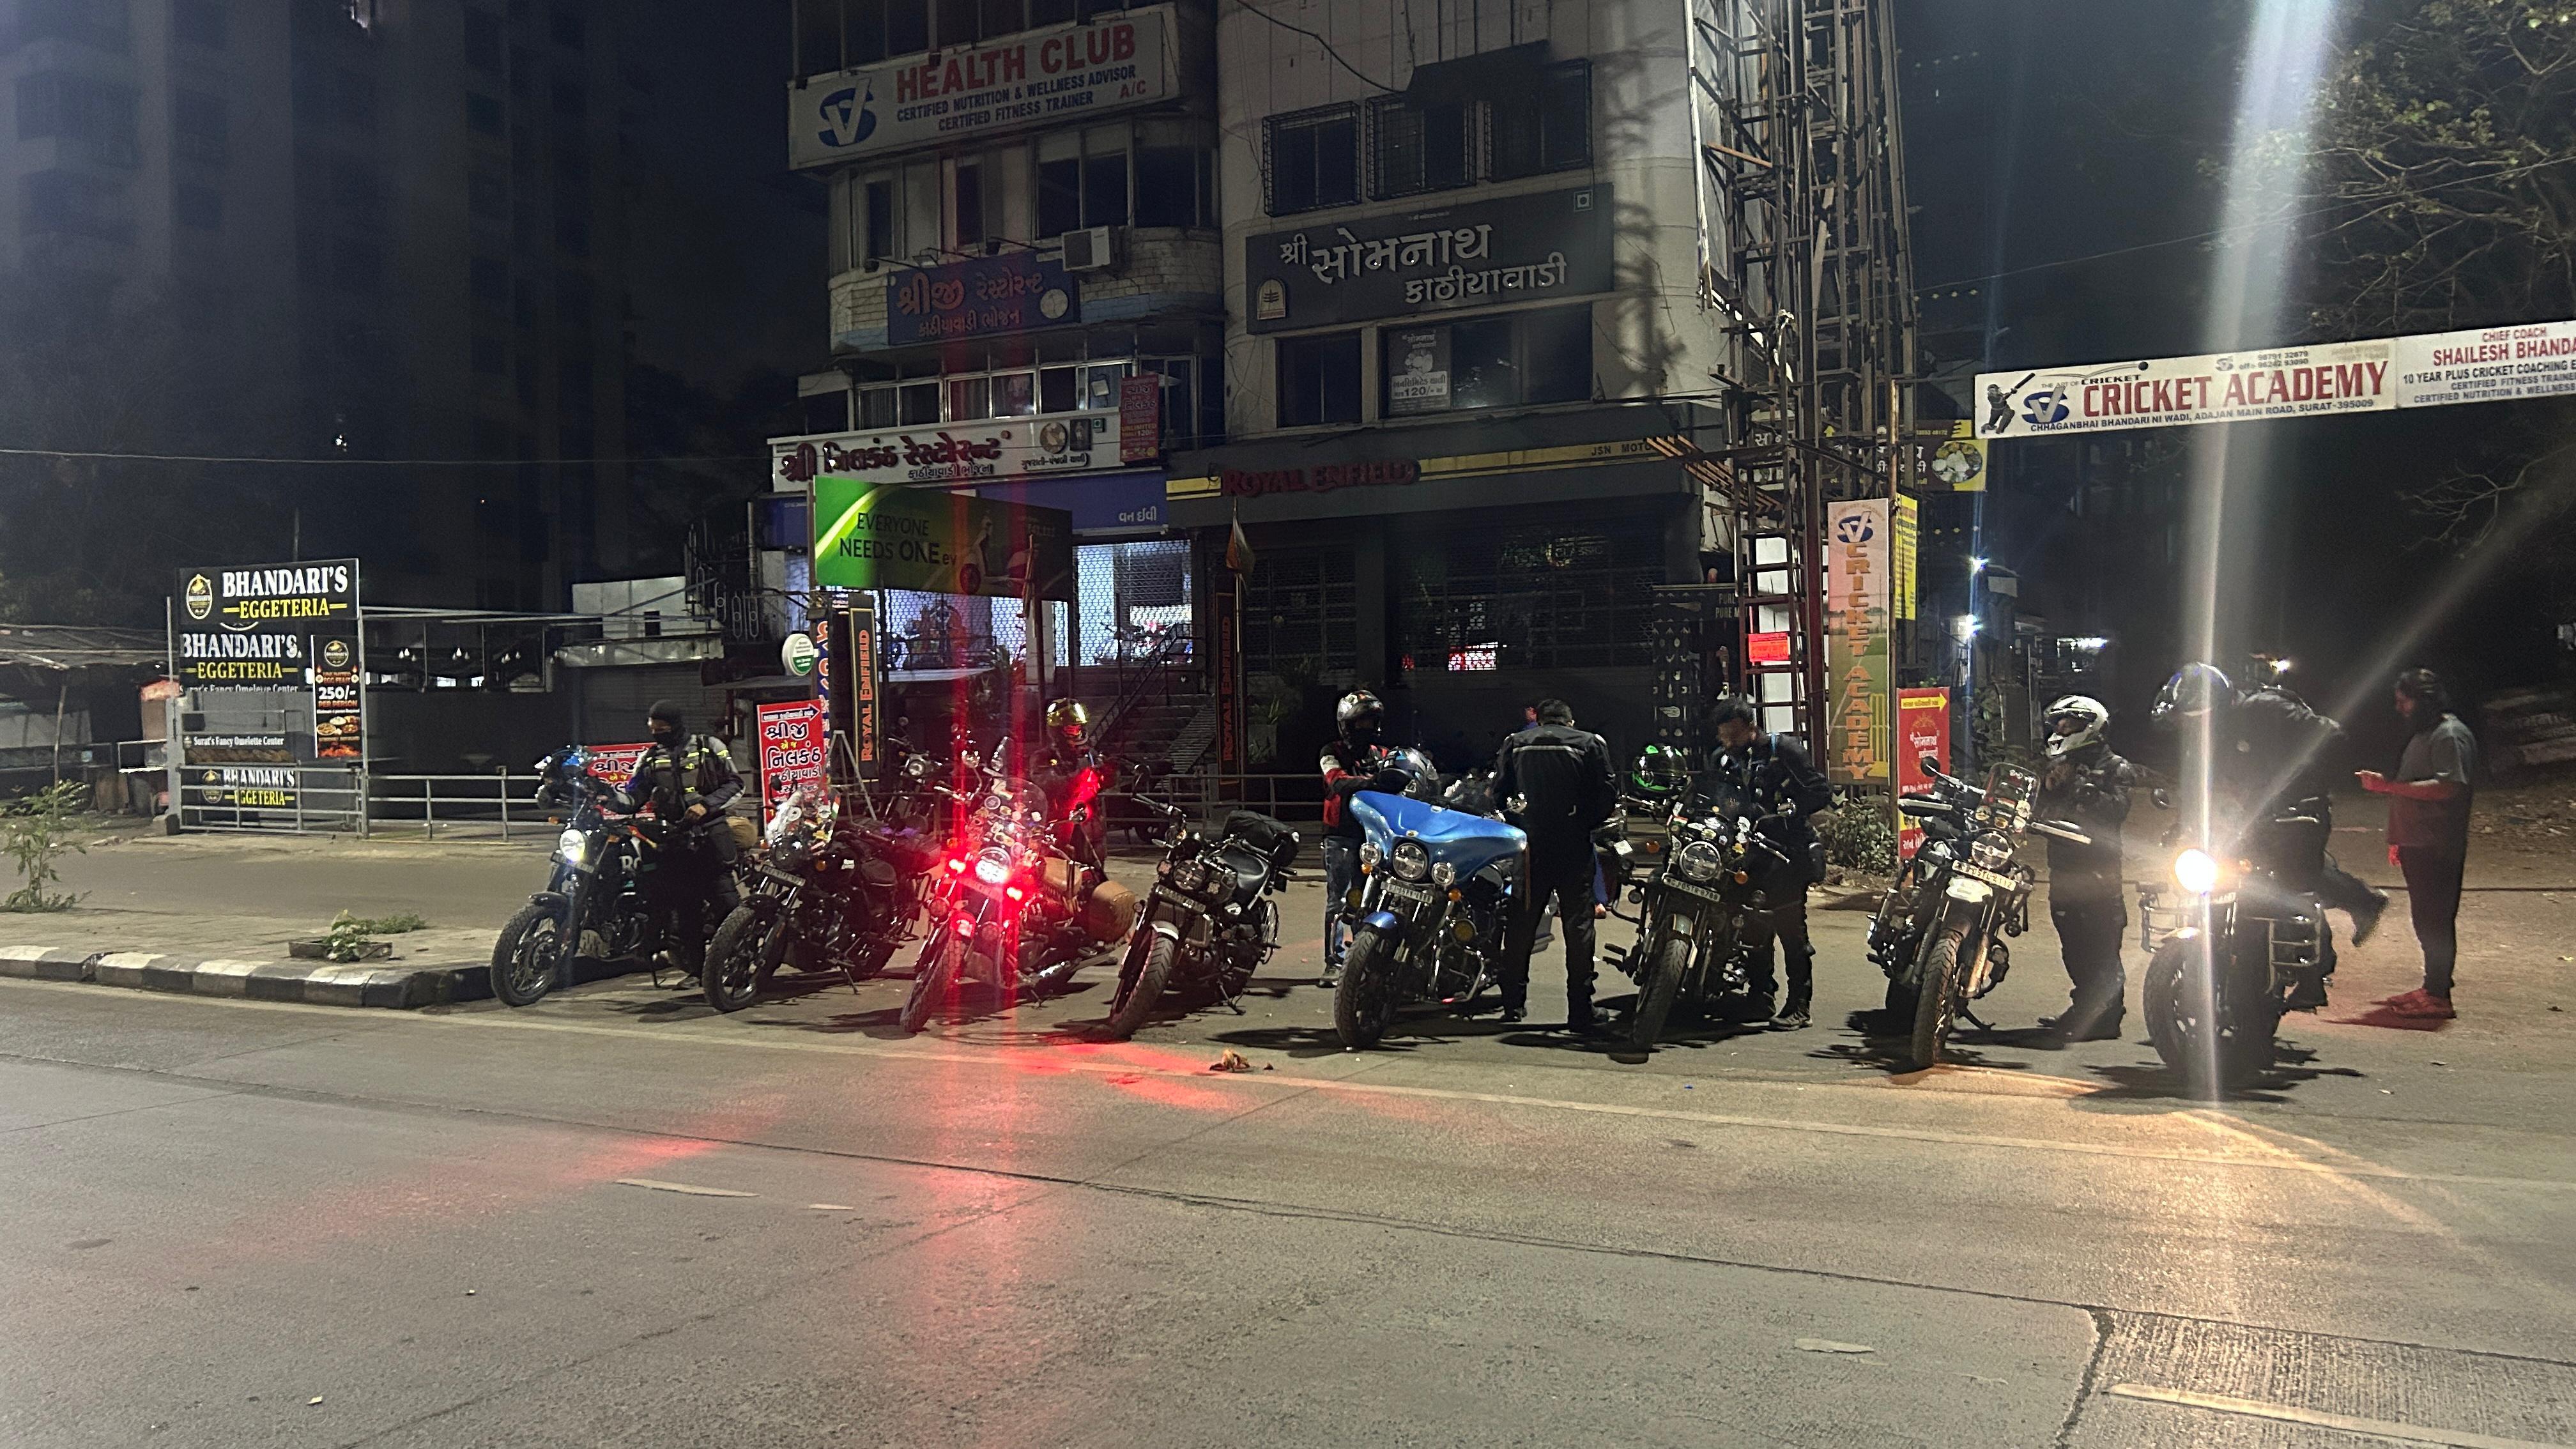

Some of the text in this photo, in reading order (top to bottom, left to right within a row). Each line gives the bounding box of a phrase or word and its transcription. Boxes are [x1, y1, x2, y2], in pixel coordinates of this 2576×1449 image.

[896, 24, 1135, 103] HEALTH CLUB
[897, 65, 1136, 122] CERTIFIED NUTRITION & WELLNESS ADVISOR
[1120, 80, 1146, 99] A/C
[939, 91, 1094, 131] CERTIFIED FITNESS TRAINER
[1279, 224, 1494, 285] શ્રી સોમનાથ
[1405, 252, 1567, 304] કાઠીયાવાડી
[898, 272, 965, 315] શ્રીજી
[2482, 326, 2547, 342] CHIEF COACH
[2434, 343, 2509, 366] SHAILESH
[2082, 374, 2141, 385] CRICKET
[2404, 375, 2414, 384] 10
[2417, 371, 2441, 383] YEAR
[2446, 369, 2469, 381] PLUS
[2472, 365, 2514, 378] CRICKET
[2517, 361, 2568, 374] COACHING
[2451, 378, 2496, 390] CERTIFIED
[2501, 376, 2538, 386] FITNESS
[2083, 376, 2212, 418] CRICKET
[2223, 361, 2389, 410] ACADEMY
[2414, 393, 2459, 404] CERTIFIED
[2464, 388, 2512, 399] NUTRITION
[2527, 382, 2575, 394] WELLNESS
[2030, 419, 2099, 432] CHHAGANBHAI
[2101, 416, 2150, 427] BHANDARI
[2152, 415, 2163, 424] NI
[2165, 413, 2192, 423] WADI,
[2195, 408, 2234, 420] ADAJAN
[2236, 406, 2263, 417] MAIN
[2266, 404, 2296, 416] ROAD,
[779, 443, 817, 481] શ્રી
[1591, 446, 1611, 456] JSN
[1223, 459, 1418, 498] ROYAL ENFIELD
[857, 512, 929, 537] EVERYONE
[1119, 512, 1134, 522] વન
[839, 538, 893, 562] NEEDS
[900, 539, 940, 565] ONE
[222, 565, 349, 597] BHANDARI'S
[240, 598, 330, 618] EGGETERIA
[1845, 542, 1872, 657] CRICKET
[197, 661, 283, 678] EGGETERIA
[318, 685, 356, 700] 250/-
[859, 629, 873, 762] ROYAL ENFIELD
[1221, 616, 1234, 761] ROYAL ENFIELD
[764, 721, 809, 739] શ્રીજી
[1842, 665, 1874, 779] ACADEMY
[194, 736, 284, 747] Surat's Fancy Omelette Center
[767, 740, 822, 769] નિલકંઠ
